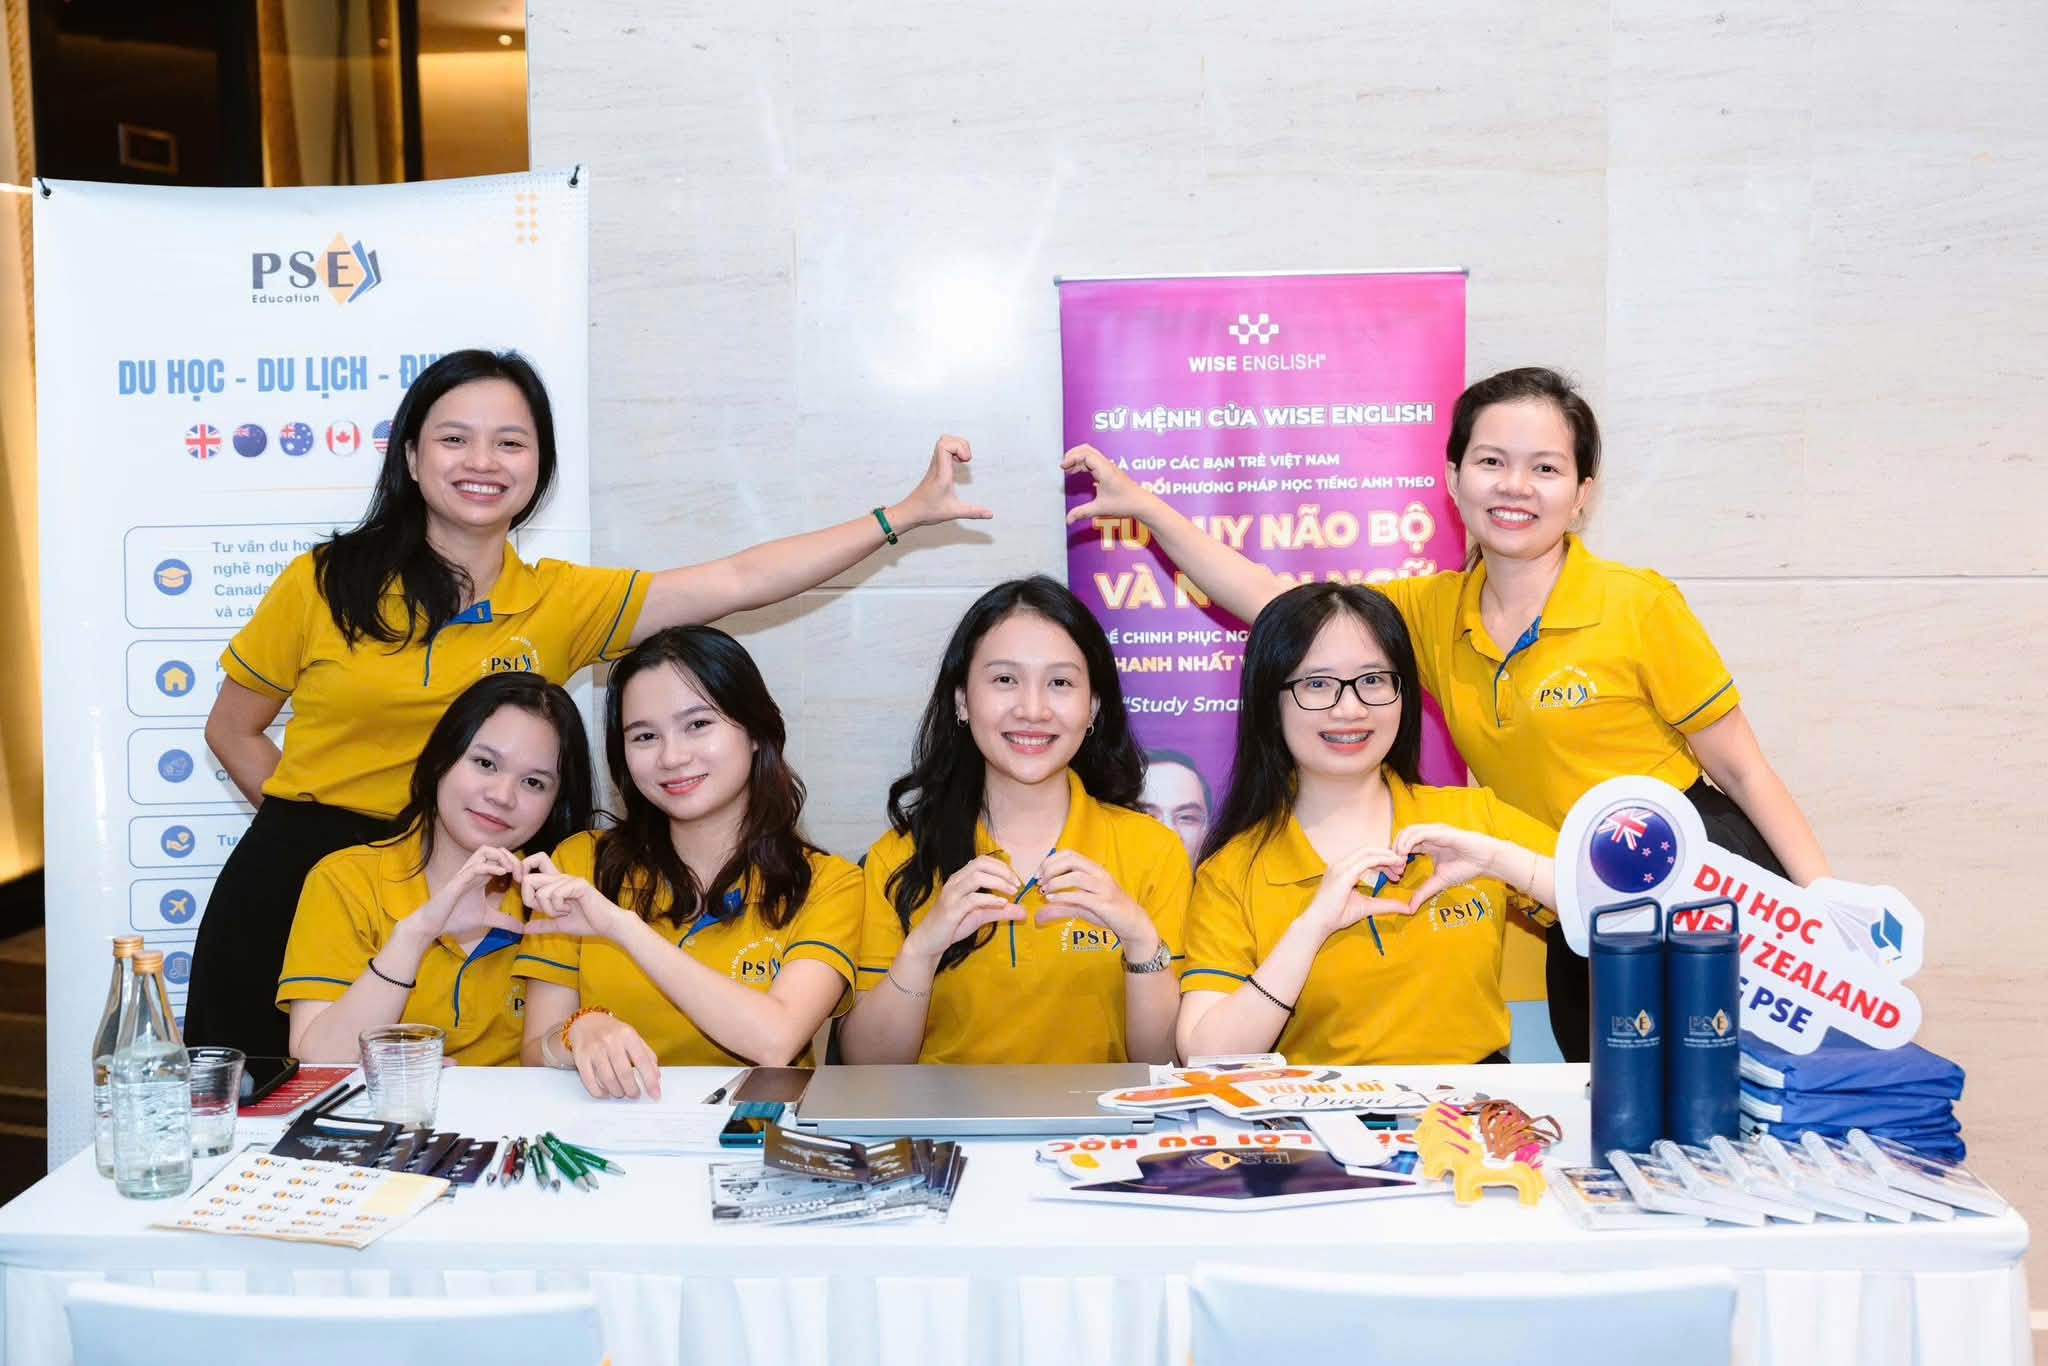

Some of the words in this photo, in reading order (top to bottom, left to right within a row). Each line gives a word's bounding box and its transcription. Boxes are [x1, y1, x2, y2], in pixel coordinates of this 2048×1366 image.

[251, 250, 355, 290] PSE
[251, 293, 320, 304] Education
[1188, 356, 1238, 373] WISE
[119, 359, 157, 395] DU
[167, 358, 225, 402] HỌC
[257, 357, 295, 393] DU
[305, 355, 368, 400] LỊCH
[1094, 406, 1128, 430] SỨ
[1132, 405, 1202, 434] MỆNH
[1207, 402, 1258, 428] CỦA
[1263, 406, 1326, 426] WISE
[1331, 402, 1434, 424] ENGLISH
[1131, 456, 1167, 470] GIÚP
[1170, 456, 1201, 470] CÁC
[1203, 457, 1236, 472] BẠN
[1238, 452, 1267, 467] TRẺ
[1270, 453, 1302, 469] VIỆT
[1305, 454, 1340, 466] NAM
[1173, 480, 1234, 494] PHƯƠNG
[1238, 477, 1278, 492] PHÁP
[1281, 479, 1313, 493] HỌC
[1315, 474, 1358, 490] TIẾNG
[1361, 477, 1393, 489] ANH
[1396, 476, 1435, 488] THEO
[1260, 503, 1360, 550] NÃO
[1368, 501, 1436, 553] BỘ
[212, 542, 234, 553] Tư
[269, 540, 289, 552] du
[1093, 562, 1168, 609] VÀ
[216, 604, 233, 617] và
[1122, 631, 1174, 644] CHINH
[1177, 630, 1223, 647] PHỤC
[1114, 656, 1172, 673] HANH
[1178, 650, 1235, 672] NHẤT
[1693, 864, 1748, 904] DU
[1747, 891, 1823, 945] HỌC
[1753, 941, 1901, 1029] ZEALAND
[1749, 986, 1813, 1034] PSE
[1047, 1137, 1138, 1153] HỌC
[1158, 1135, 1218, 1148] DU
